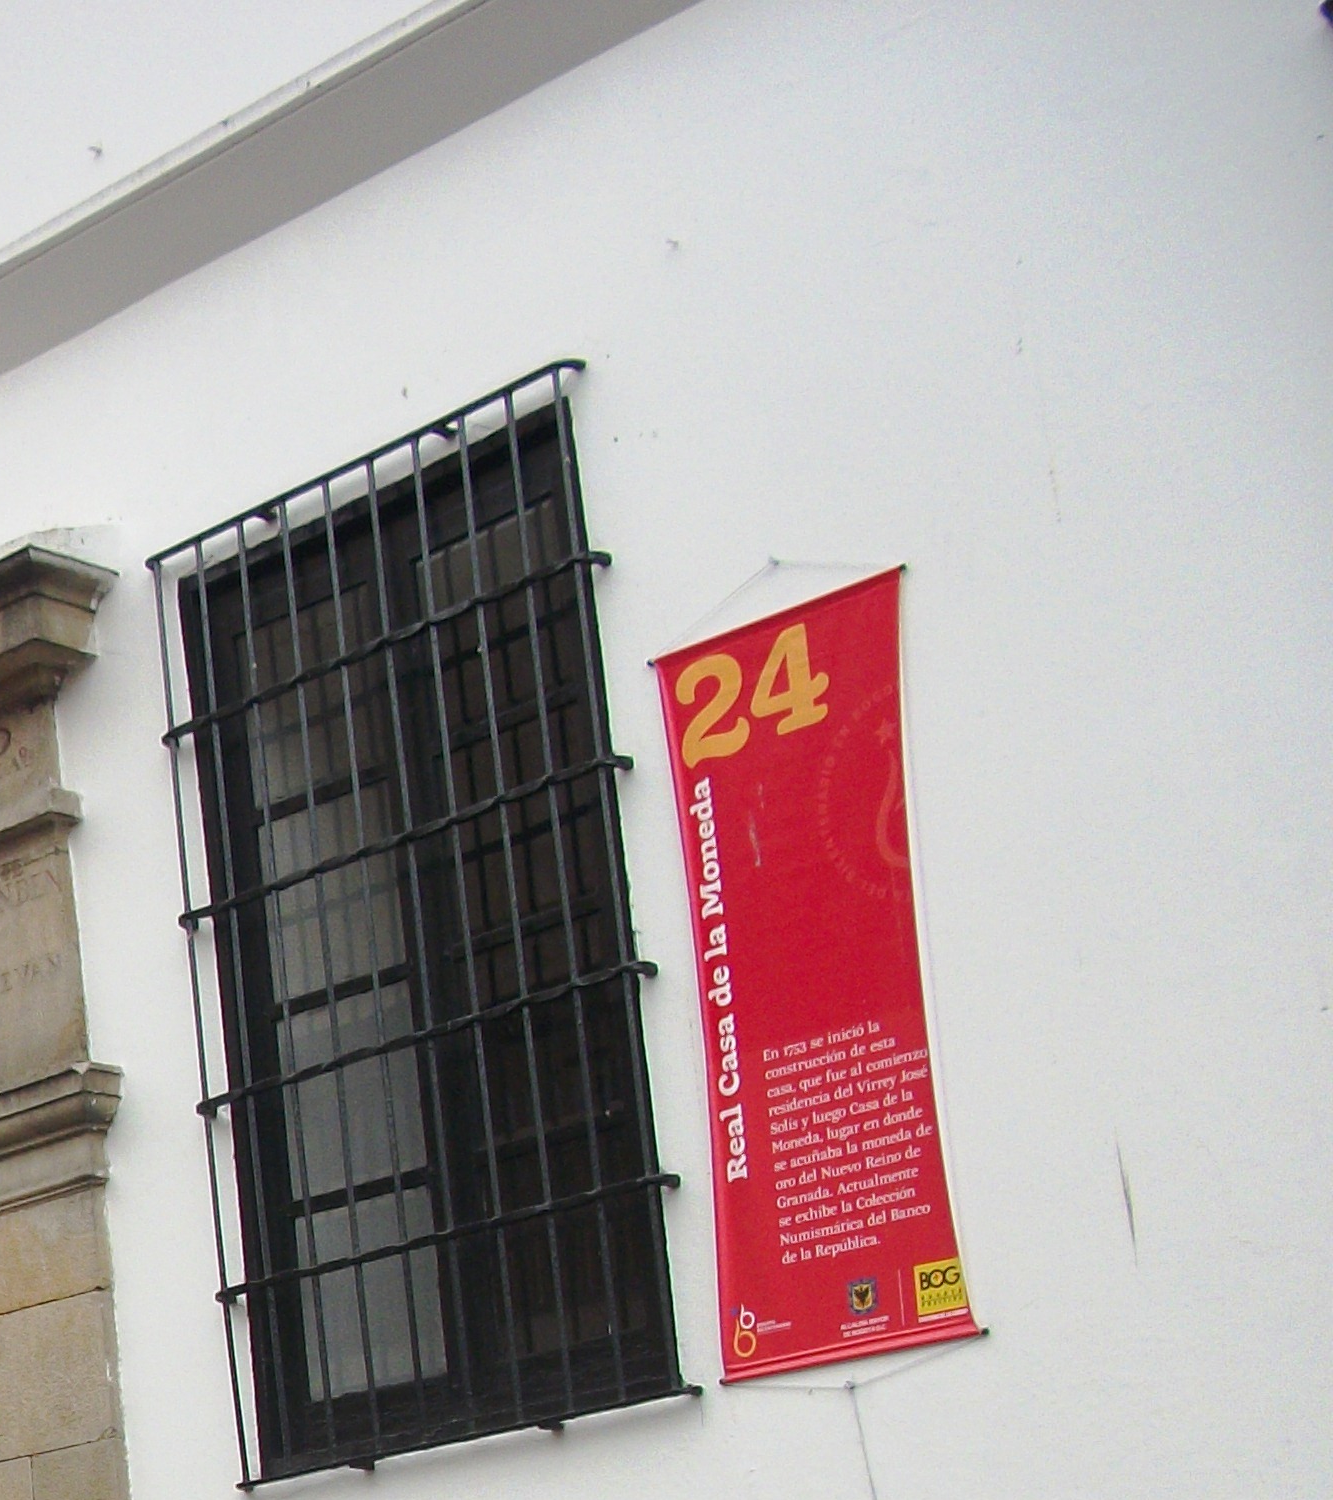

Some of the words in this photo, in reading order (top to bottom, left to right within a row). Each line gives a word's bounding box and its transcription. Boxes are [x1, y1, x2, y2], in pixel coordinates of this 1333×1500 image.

[675, 623, 829, 769] 24
[689, 777, 725, 921] Moneda
[704, 923, 728, 961] la
[708, 965, 731, 1007] de
[718, 1013, 742, 1098] Casa
[763, 1049, 779, 1062] En
[783, 1042, 807, 1057] 1753
[810, 1037, 823, 1049] se
[828, 1023, 864, 1045] inició
[868, 1020, 880, 1033] la
[765, 1049, 846, 1080] construcción
[850, 1044, 866, 1057] de
[870, 1037, 896, 1052] esta
[768, 1091, 831, 1117] residencia
[834, 1083, 853, 1100] del
[856, 1075, 897, 1094] Virrey
[900, 1065, 928, 1083] José
[798, 1075, 823, 1092] que
[825, 1069, 847, 1083] fue
[850, 1062, 862, 1076] al
[866, 1049, 928, 1073] comienzo
[770, 1116, 798, 1136] Solís
[801, 1116, 809, 1127] y
[812, 1107, 847, 1125] luego
[849, 1099, 879, 1115] Casa
[883, 1093, 898, 1107] de
[901, 1088, 913, 1101] la
[771, 1131, 823, 1154] Moneda,
[827, 1123, 860, 1141] lugar
[863, 1118, 879, 1131] en
[883, 1105, 923, 1126] donde
[719, 1103, 748, 1183] Real
[774, 1159, 787, 1173] se
[790, 1146, 843, 1169] acuñaba
[846, 1141, 858, 1155] la
[862, 1127, 912, 1151] moneda
[915, 1123, 932, 1139] de
[775, 1177, 796, 1191] oro
[798, 1168, 817, 1185] del
[821, 1162, 861, 1180] Nuevo
[865, 1152, 901, 1169] Reino
[904, 1146, 921, 1160] de
[776, 1187, 833, 1209] Granada.
[837, 1167, 919, 1196] Actualmente
[779, 1215, 792, 1228] se
[795, 1205, 838, 1223] exhibe
[841, 1200, 852, 1214] la
[855, 1186, 916, 1210] Colección
[779, 1218, 864, 1246] Numismática
[867, 1211, 886, 1226] del
[890, 1204, 931, 1222] Banco
[781, 1250, 797, 1265] de
[800, 1247, 812, 1261] la
[815, 1234, 881, 1257] República.
[919, 1266, 960, 1291] BOG
